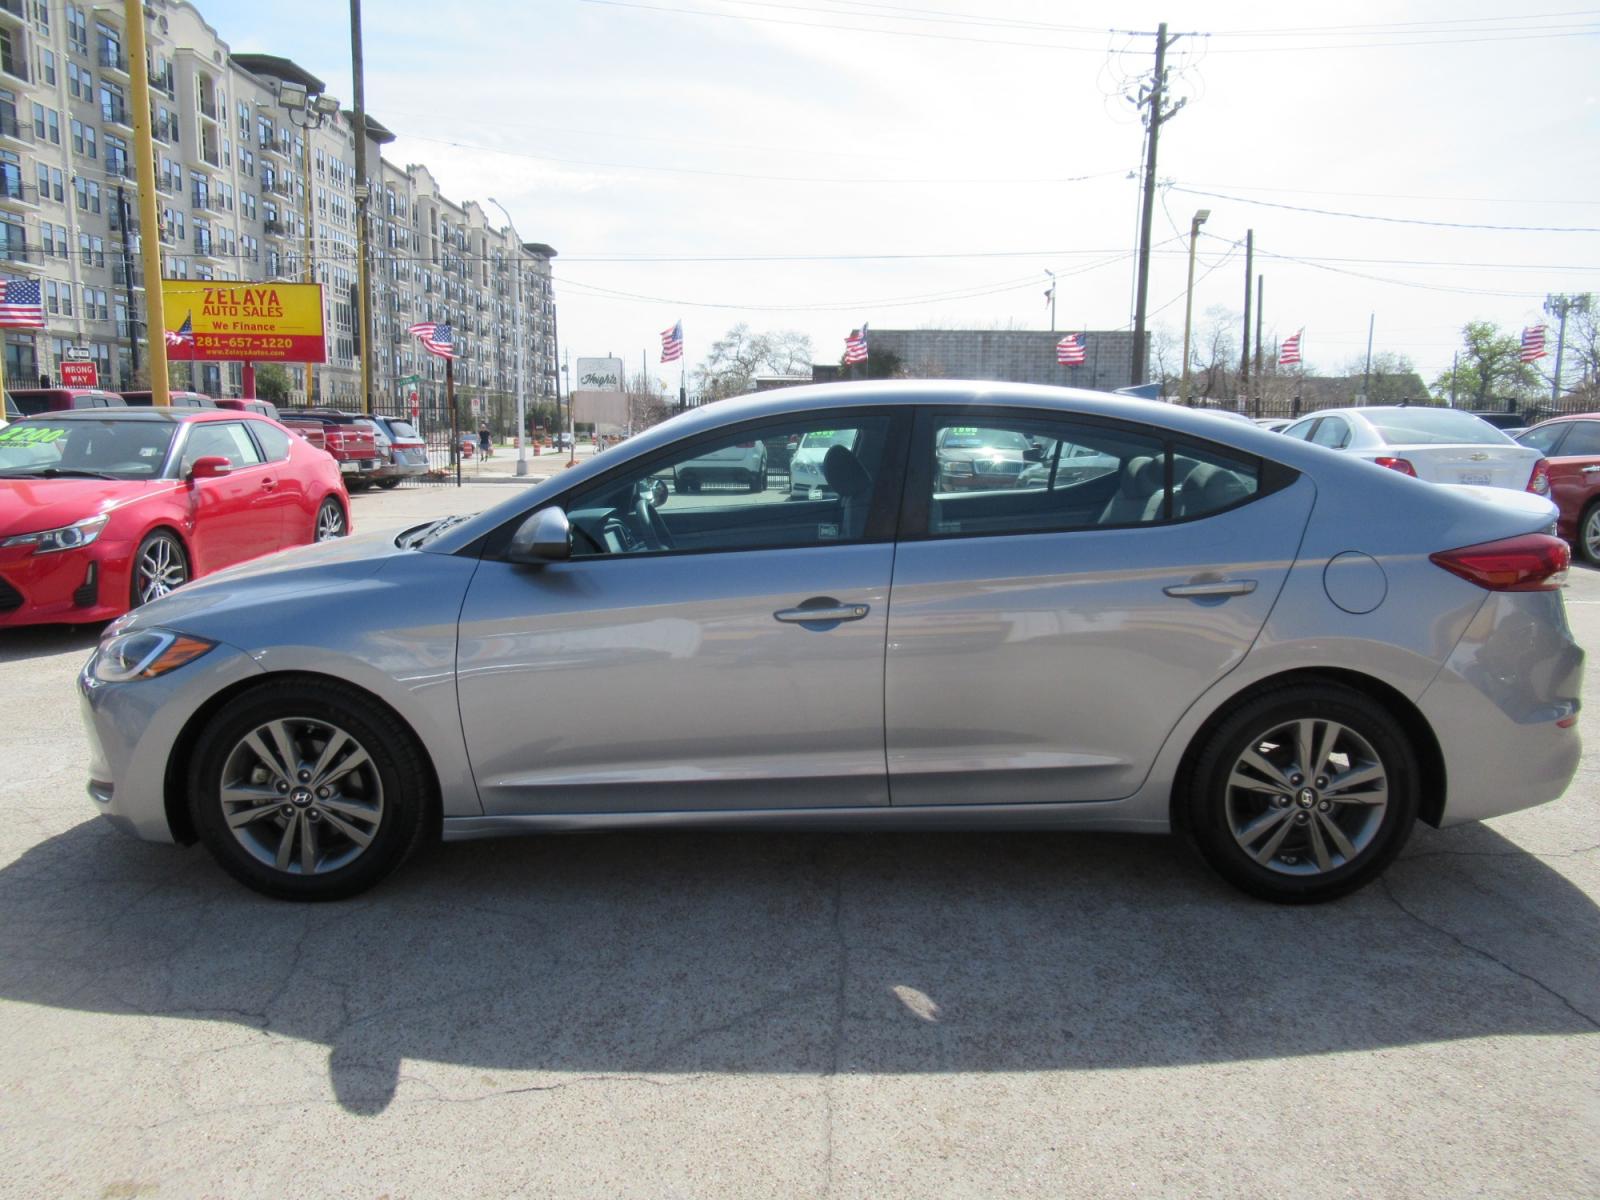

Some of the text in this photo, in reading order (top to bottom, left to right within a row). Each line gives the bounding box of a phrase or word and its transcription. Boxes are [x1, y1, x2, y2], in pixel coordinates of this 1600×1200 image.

[203, 287, 280, 306] ZELAYA
[202, 305, 284, 318] AUTO SALES
[212, 321, 276, 332] We Finance
[196, 336, 294, 349] 281-657-1220
[64, 365, 93, 374] WRONG
[581, 373, 617, 387] Heights
